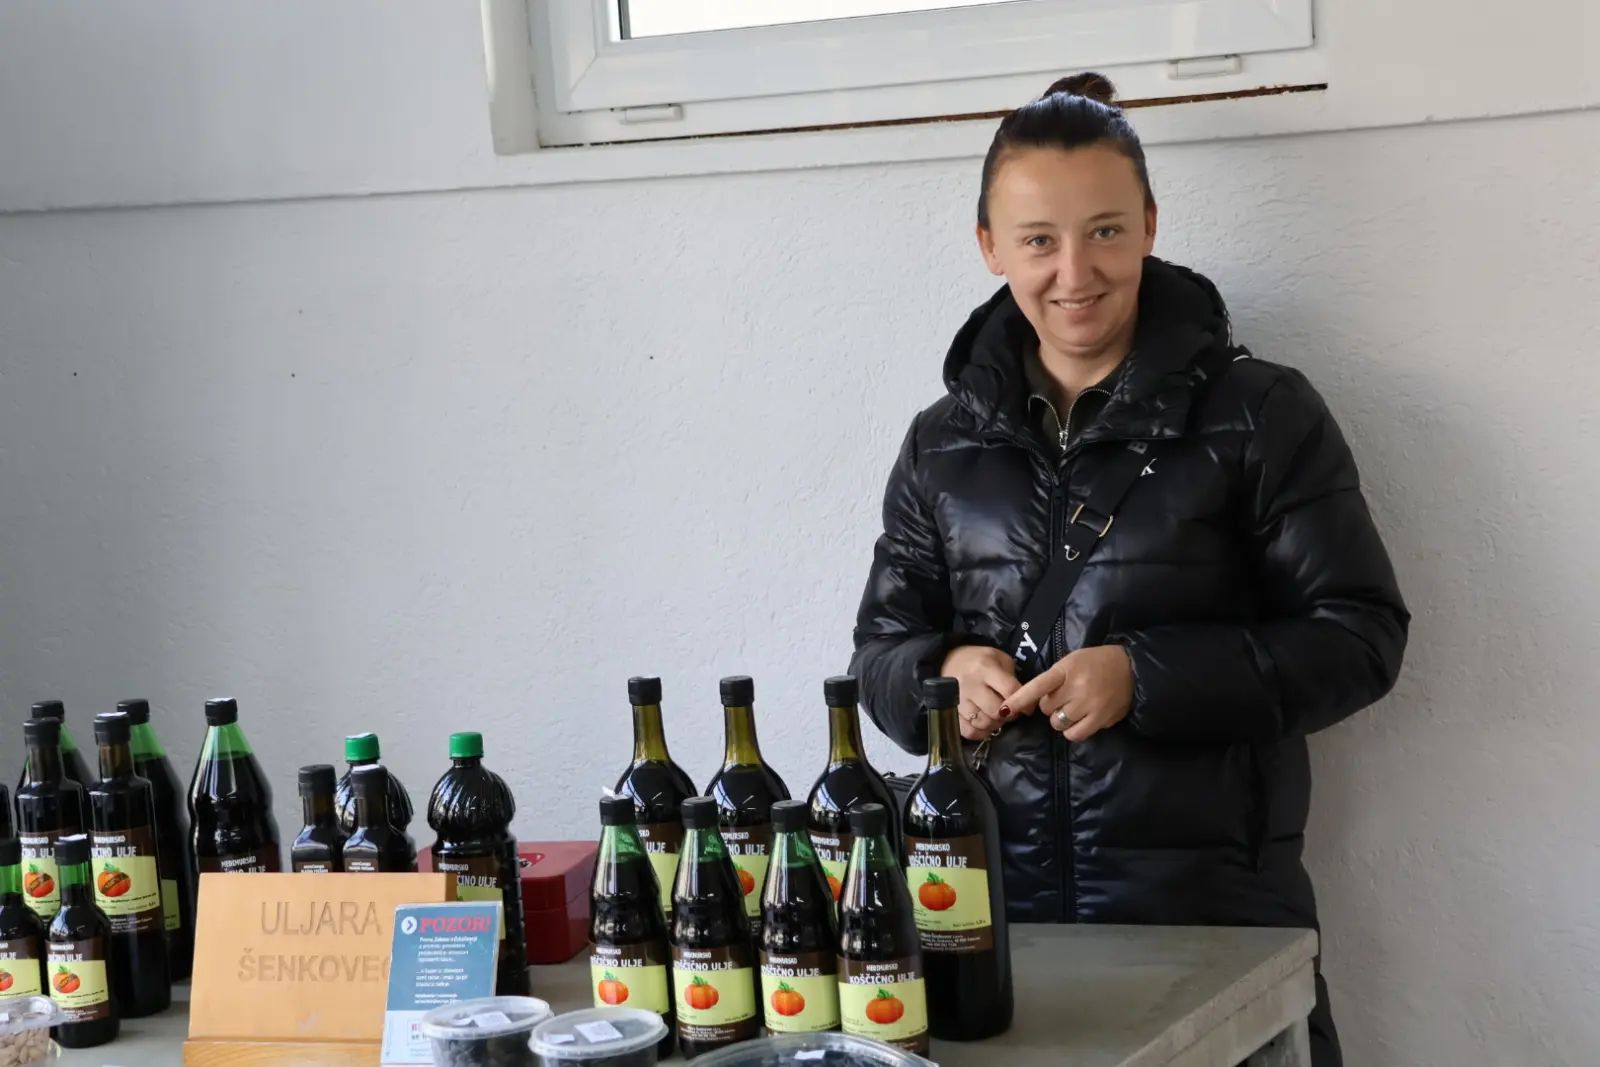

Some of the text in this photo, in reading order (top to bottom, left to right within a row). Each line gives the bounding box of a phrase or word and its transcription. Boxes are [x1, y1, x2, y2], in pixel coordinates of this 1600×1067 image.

[116, 846, 137, 857] ULJE
[645, 842, 666, 853] ULJE
[745, 844, 765, 855] ULJE
[946, 855, 968, 868] ULJE
[478, 876, 497, 888] ULJE
[260, 901, 384, 936] ULJARA
[419, 915, 492, 933] POZOR!
[66, 953, 83, 962] ULJE
[620, 958, 643, 968] ULJE
[711, 961, 733, 971] ULJE
[796, 967, 820, 977] ULJE
[897, 971, 916, 982] ULJE
